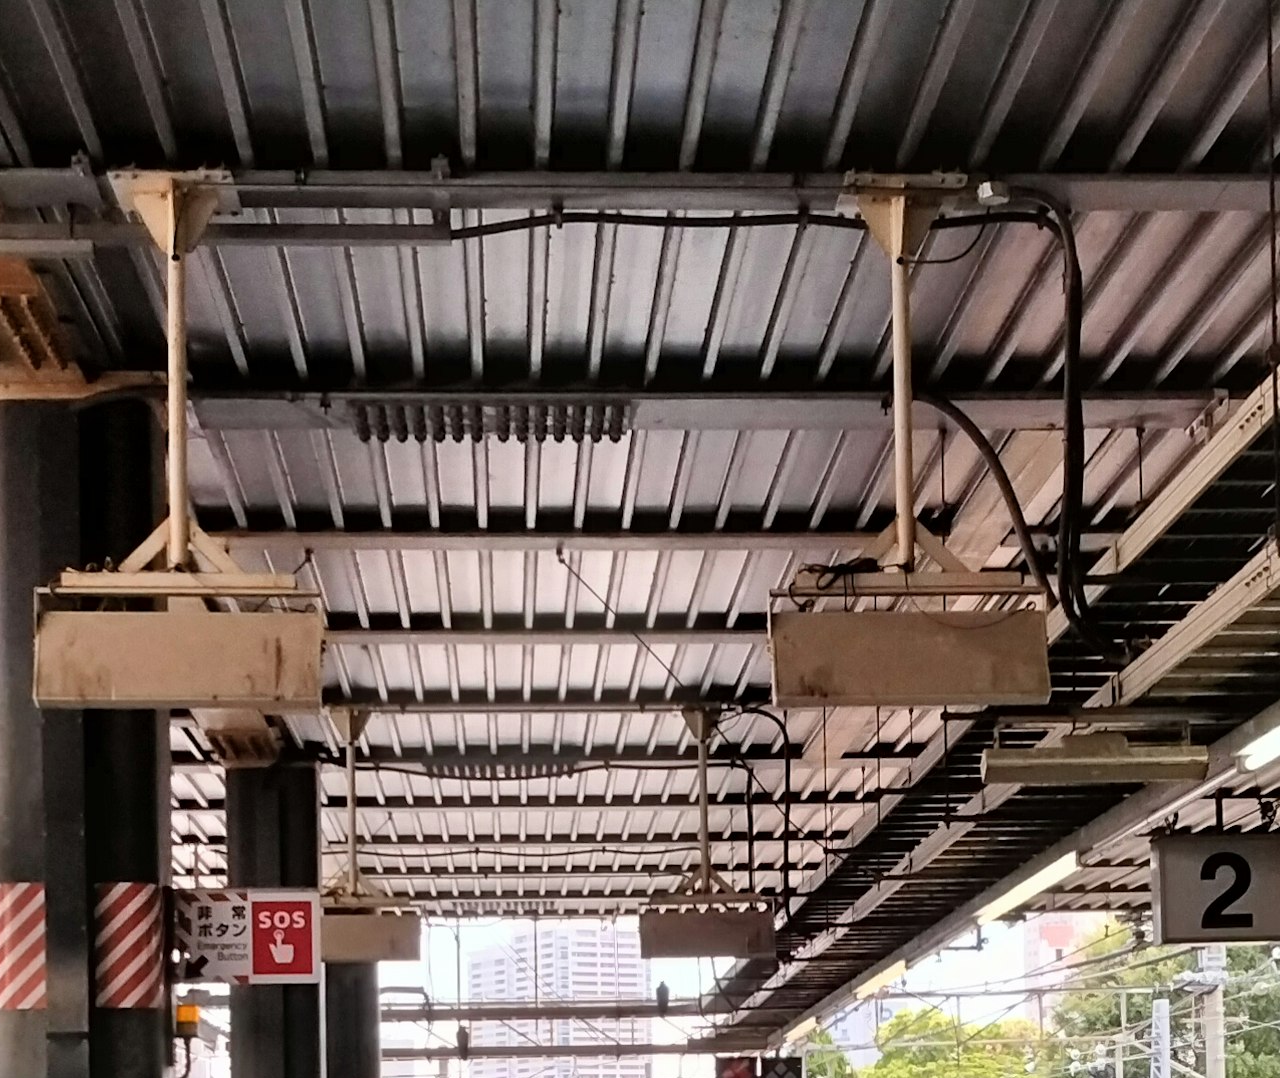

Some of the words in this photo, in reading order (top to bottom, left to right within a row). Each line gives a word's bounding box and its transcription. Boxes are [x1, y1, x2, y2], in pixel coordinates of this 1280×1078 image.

[1200, 851, 1254, 929] 2
[197, 905, 246, 920] 非常
[257, 910, 306, 929] SOS
[197, 923, 247, 938] ボタン
